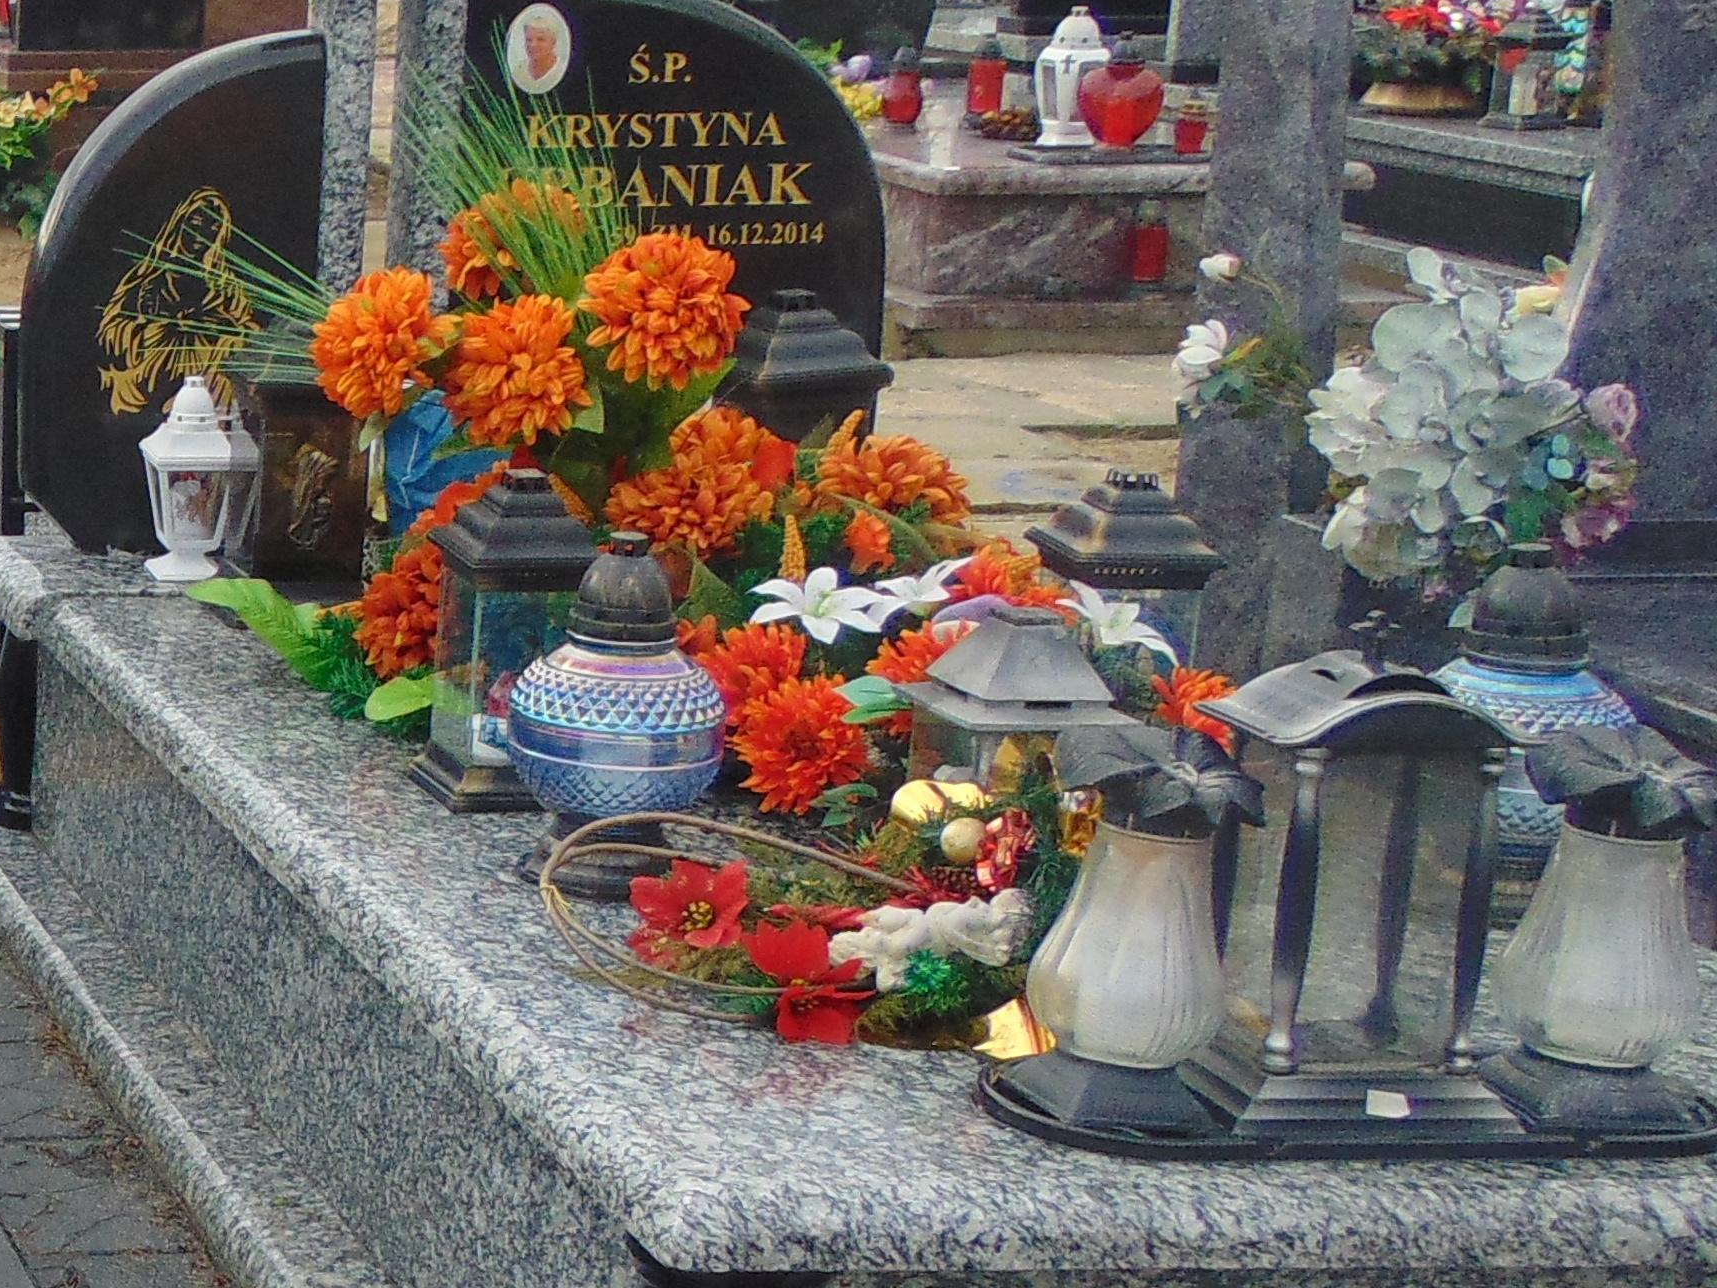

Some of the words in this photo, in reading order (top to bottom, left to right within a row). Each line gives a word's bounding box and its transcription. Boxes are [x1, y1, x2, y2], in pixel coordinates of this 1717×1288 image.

[627, 44, 693, 85] Ś.P.
[526, 112, 787, 149] KRYSTYNA
[707, 221, 827, 247] 16.12.2014
